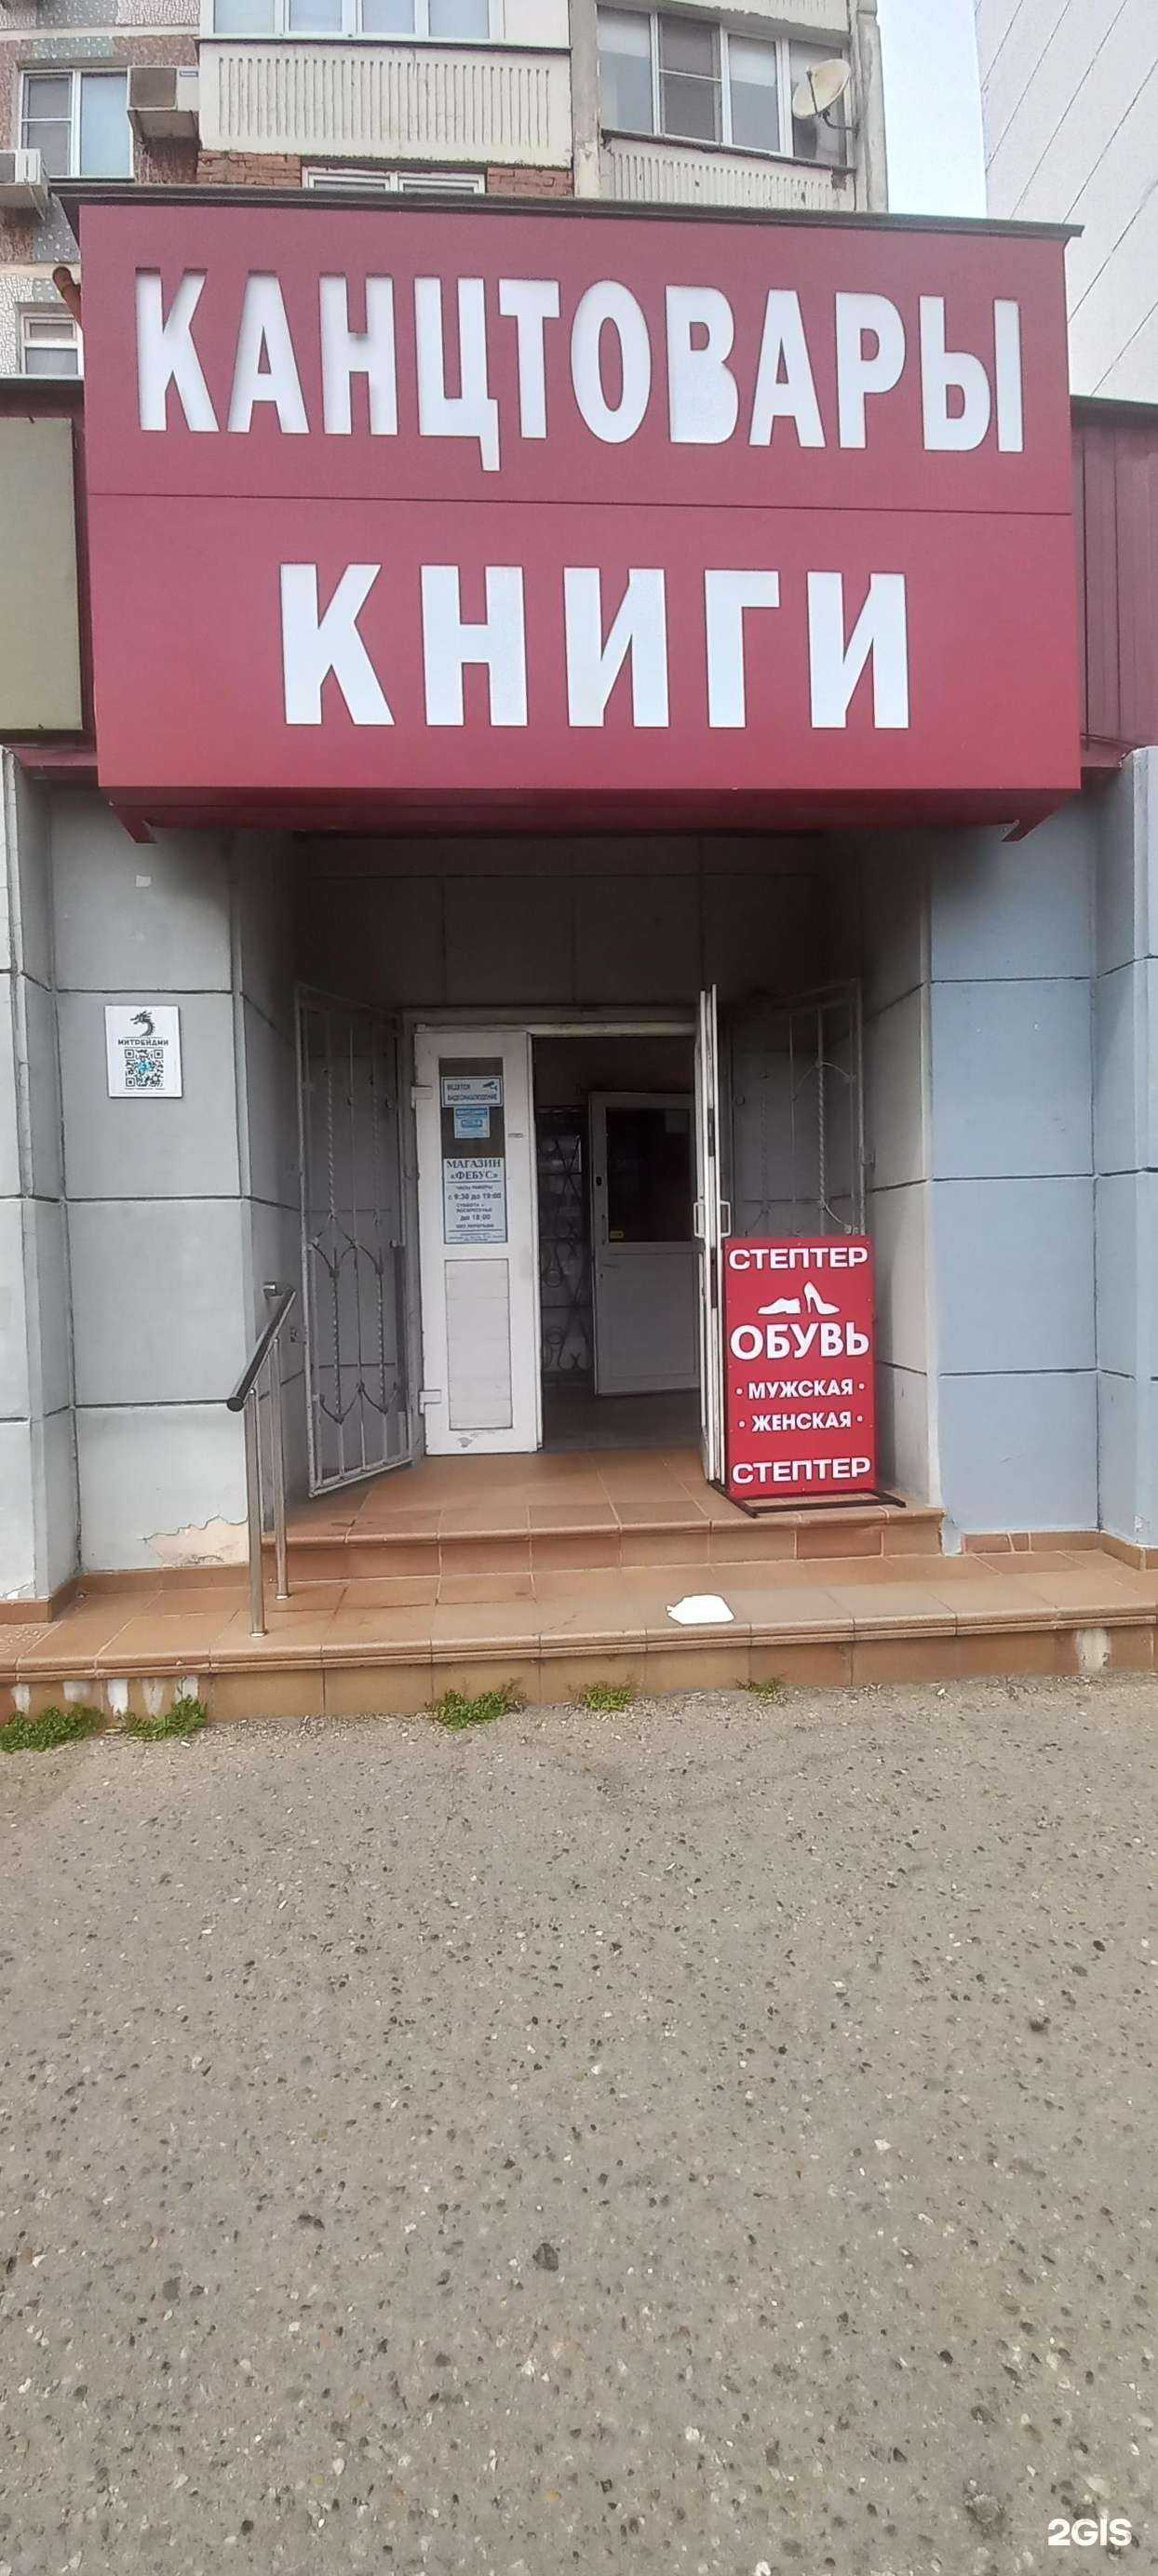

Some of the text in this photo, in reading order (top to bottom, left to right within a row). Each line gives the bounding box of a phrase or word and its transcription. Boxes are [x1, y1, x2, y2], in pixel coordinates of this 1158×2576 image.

[135, 267, 1025, 472] КАНЦТОВАРЫ
[280, 562, 910, 730] КНИГИ
[447, 1159, 501, 1169] МАГАЗИН
[451, 1171, 499, 1180] «ФЕБУС»
[729, 1247, 868, 1270] СТЕПТЕР
[730, 1322, 869, 1361] ОБУВЬ
[748, 1378, 854, 1401] МУЖСКАЯ
[752, 1411, 852, 1432] ЖЕНСКАЯ
[732, 1456, 871, 1484] СТЕПТЕР
